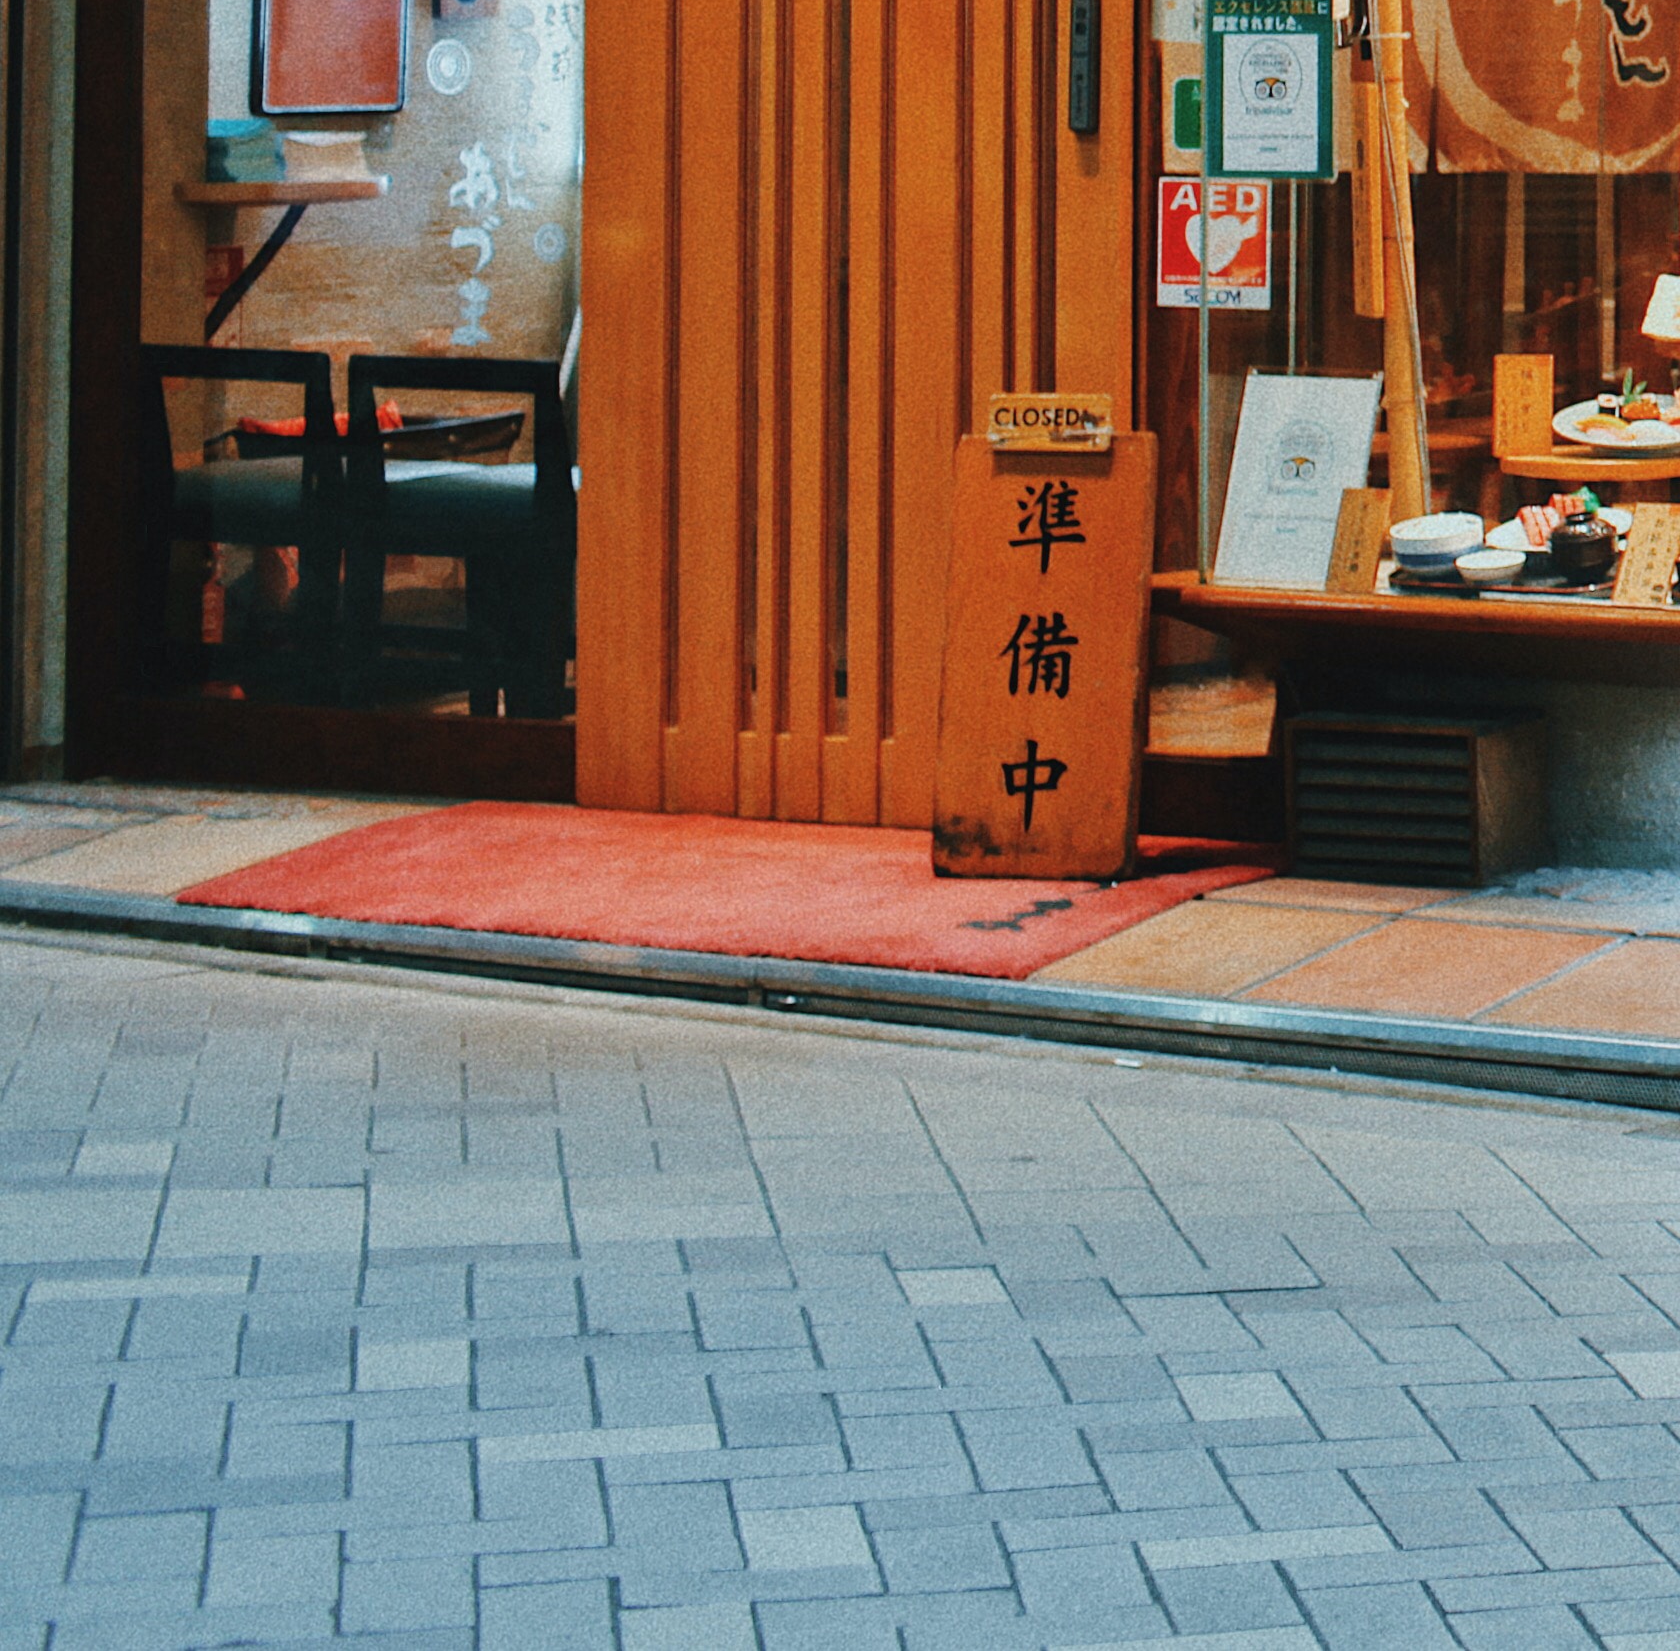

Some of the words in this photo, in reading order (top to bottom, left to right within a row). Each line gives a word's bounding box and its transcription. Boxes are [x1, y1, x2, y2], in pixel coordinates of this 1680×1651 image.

[1169, 183, 1262, 214] AED
[994, 405, 1080, 428] CLOSED
[1000, 480, 1087, 834] 準備中
